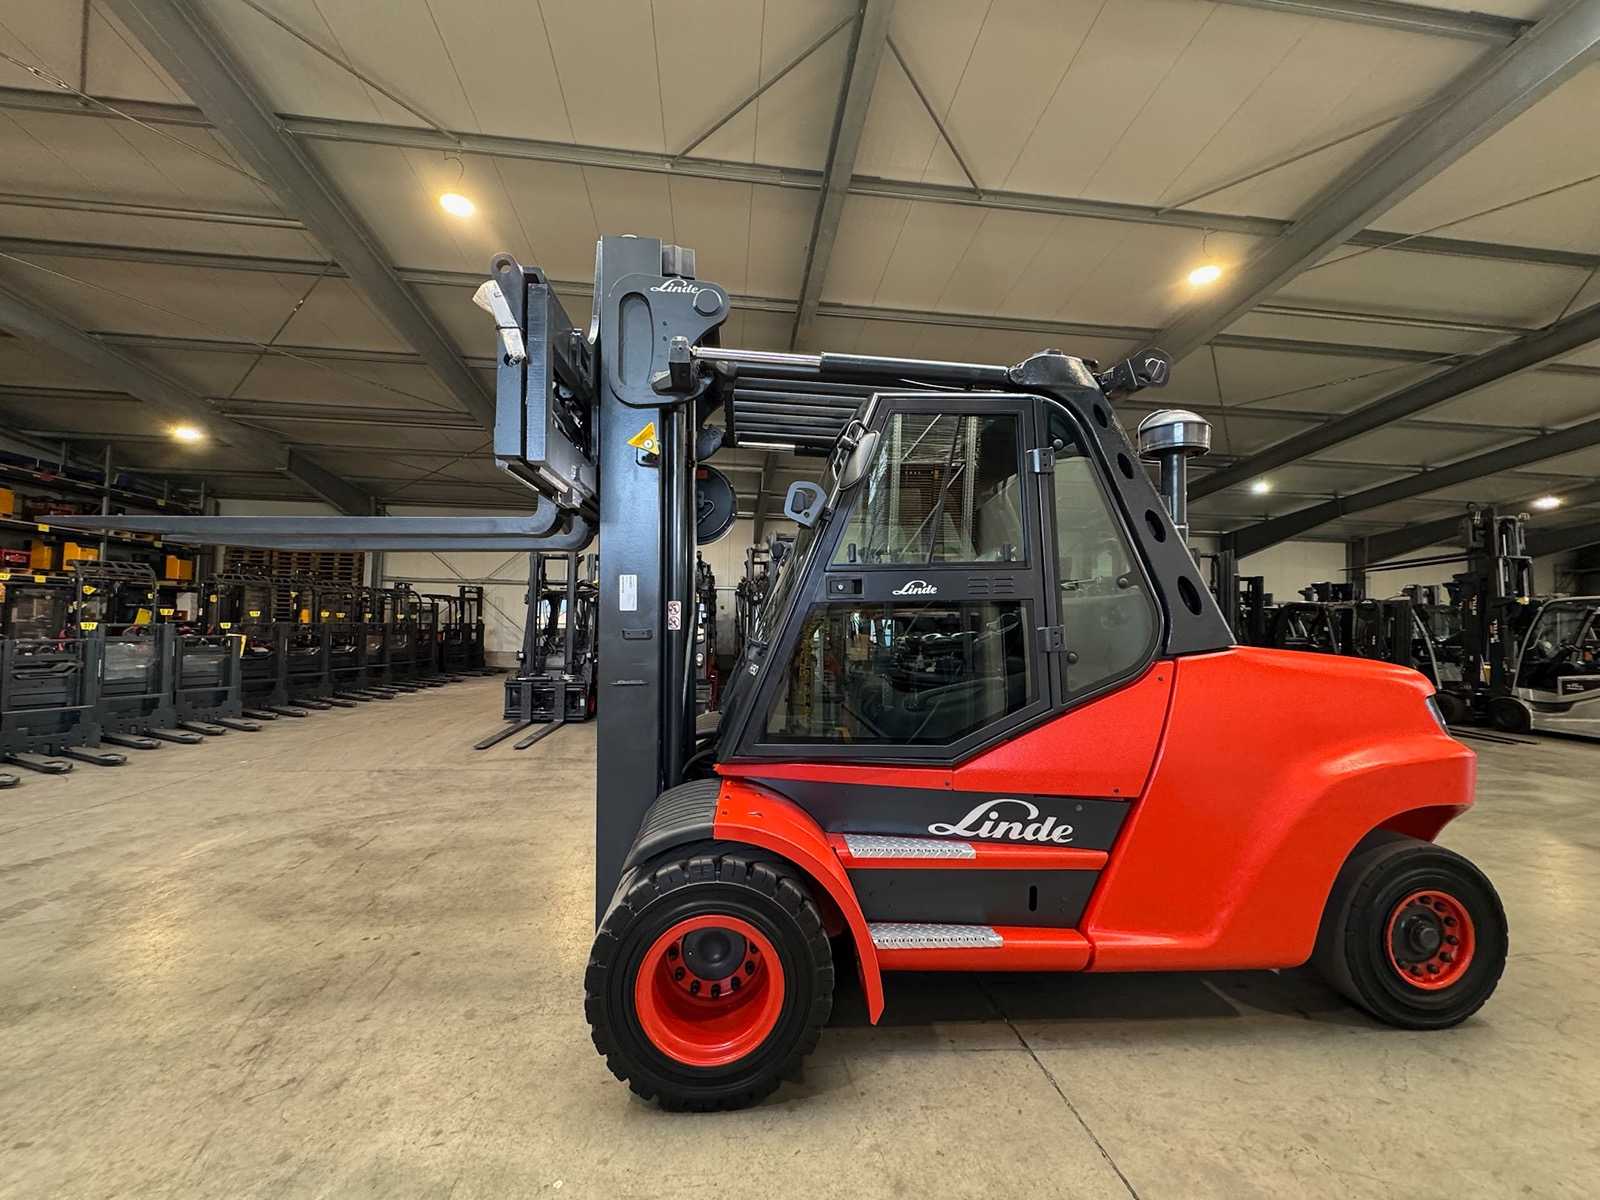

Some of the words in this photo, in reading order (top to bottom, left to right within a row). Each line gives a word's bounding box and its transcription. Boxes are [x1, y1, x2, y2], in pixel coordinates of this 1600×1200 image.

[650, 278, 699, 294] Linde
[892, 580, 938, 595] Linde
[928, 799, 1074, 843] Linde
